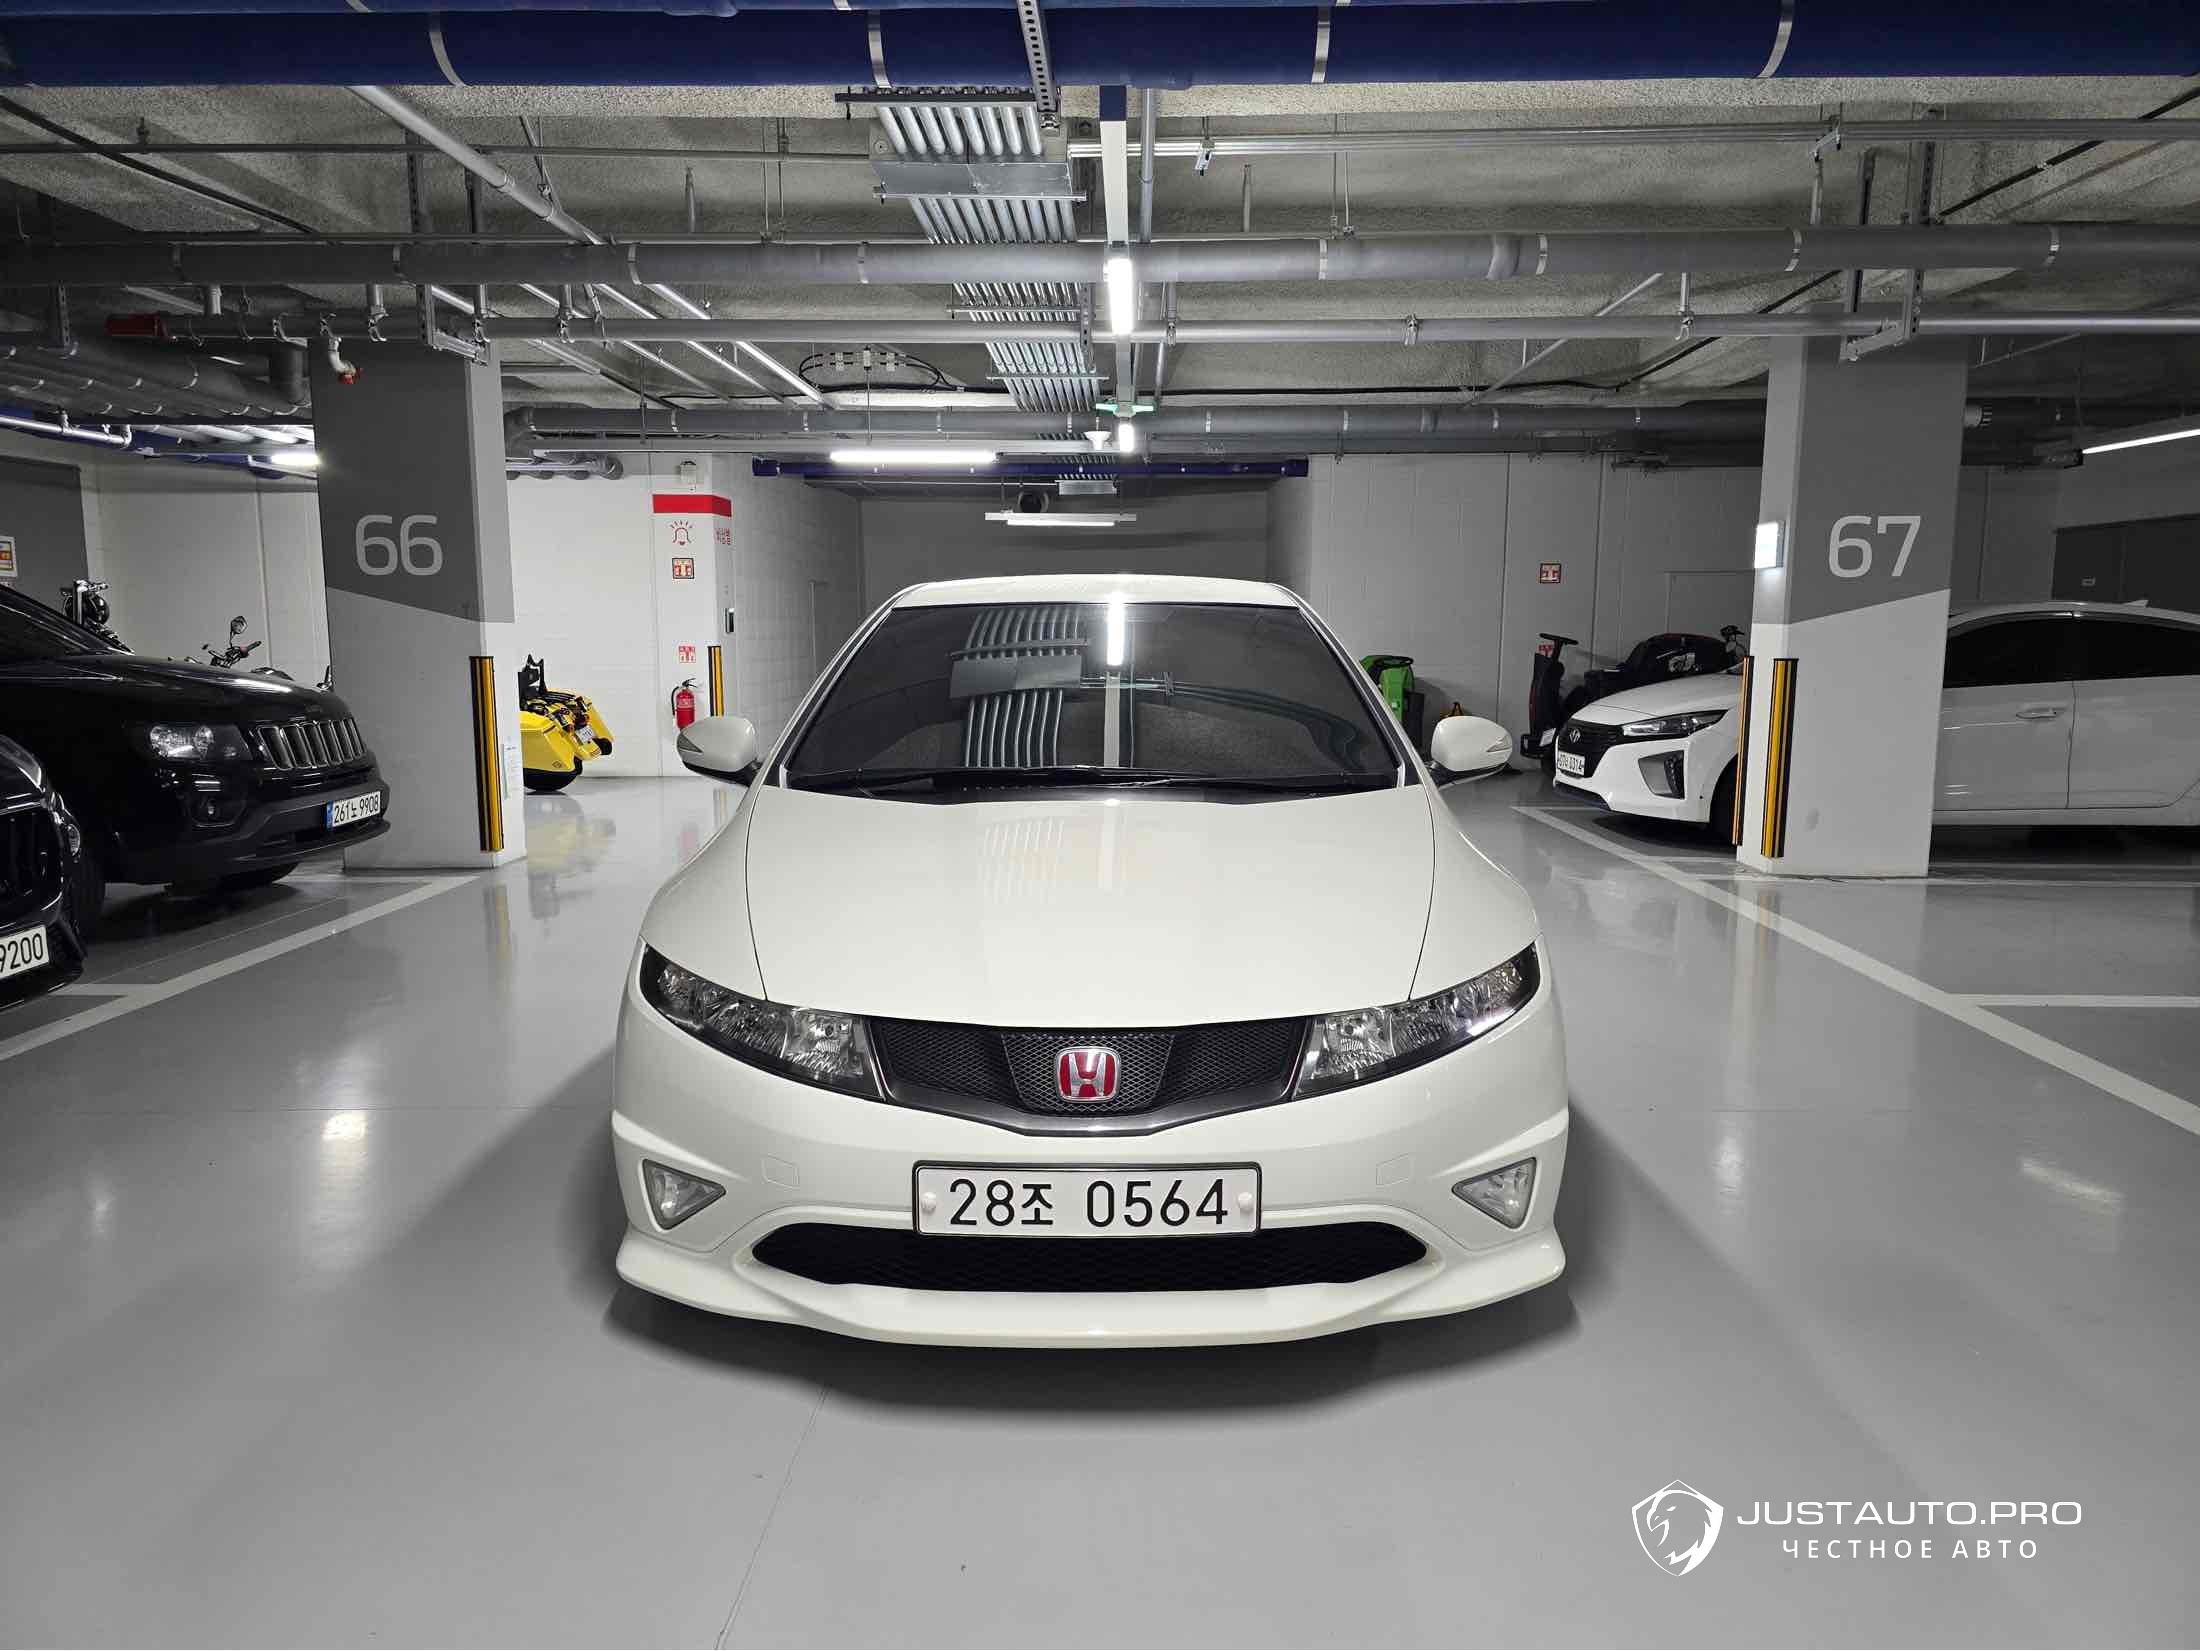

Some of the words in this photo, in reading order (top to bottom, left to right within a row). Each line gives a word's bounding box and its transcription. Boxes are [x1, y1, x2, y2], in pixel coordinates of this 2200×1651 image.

[355, 514, 443, 576] 66
[1828, 515, 1921, 577] 67
[360, 794, 379, 816] 9908
[950, 1178, 1054, 1226] 28조
[1086, 1178, 1229, 1228] 0564
